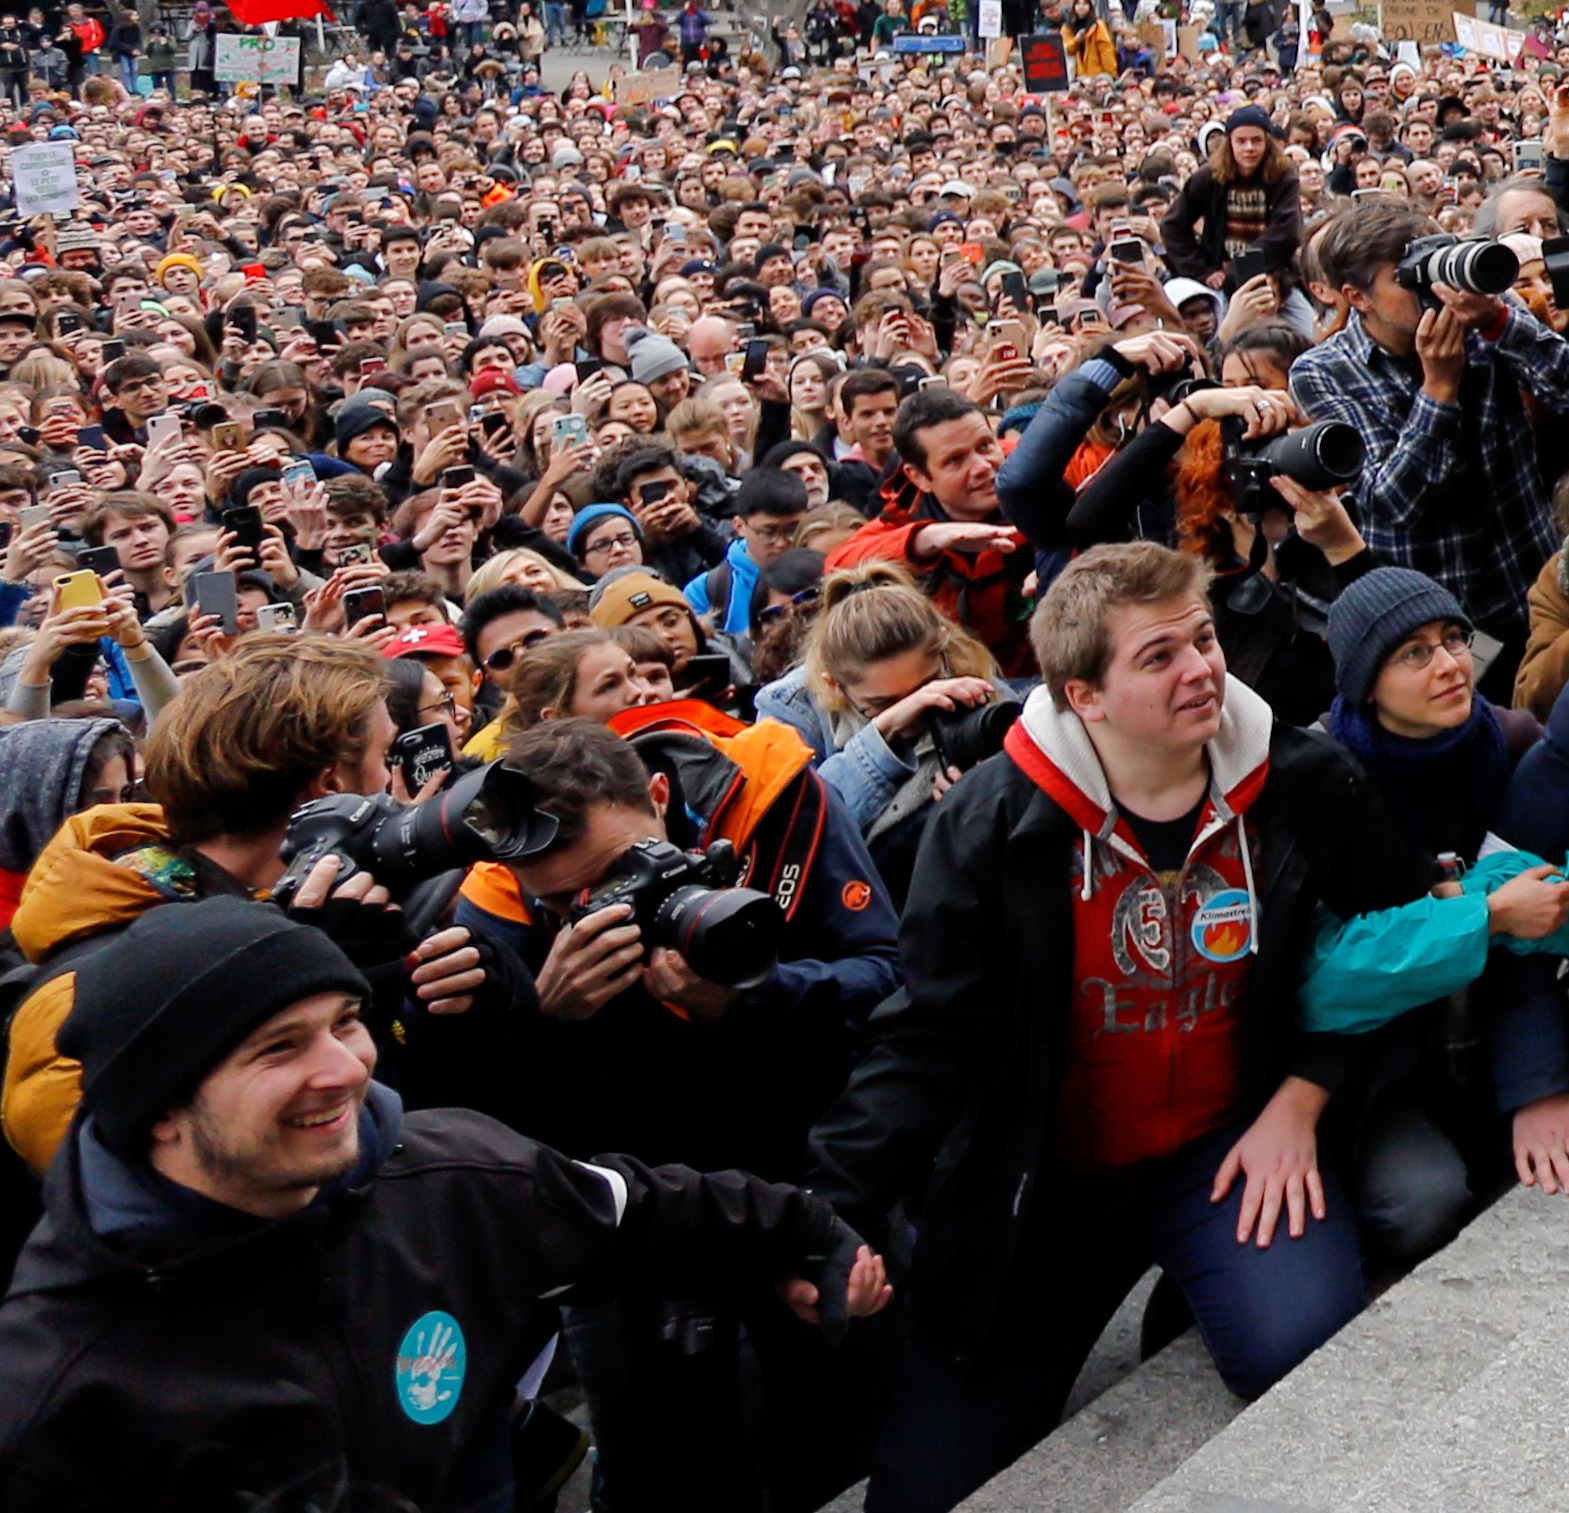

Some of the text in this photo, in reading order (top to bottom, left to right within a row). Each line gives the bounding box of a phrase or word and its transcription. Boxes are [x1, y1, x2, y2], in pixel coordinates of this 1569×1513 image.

[240, 37, 275, 51] PRO
[349, 800, 372, 823] Canon
[661, 864, 689, 879] Canon
[774, 863, 801, 910] EOS
[1200, 902, 1252, 922] Klimastrei
